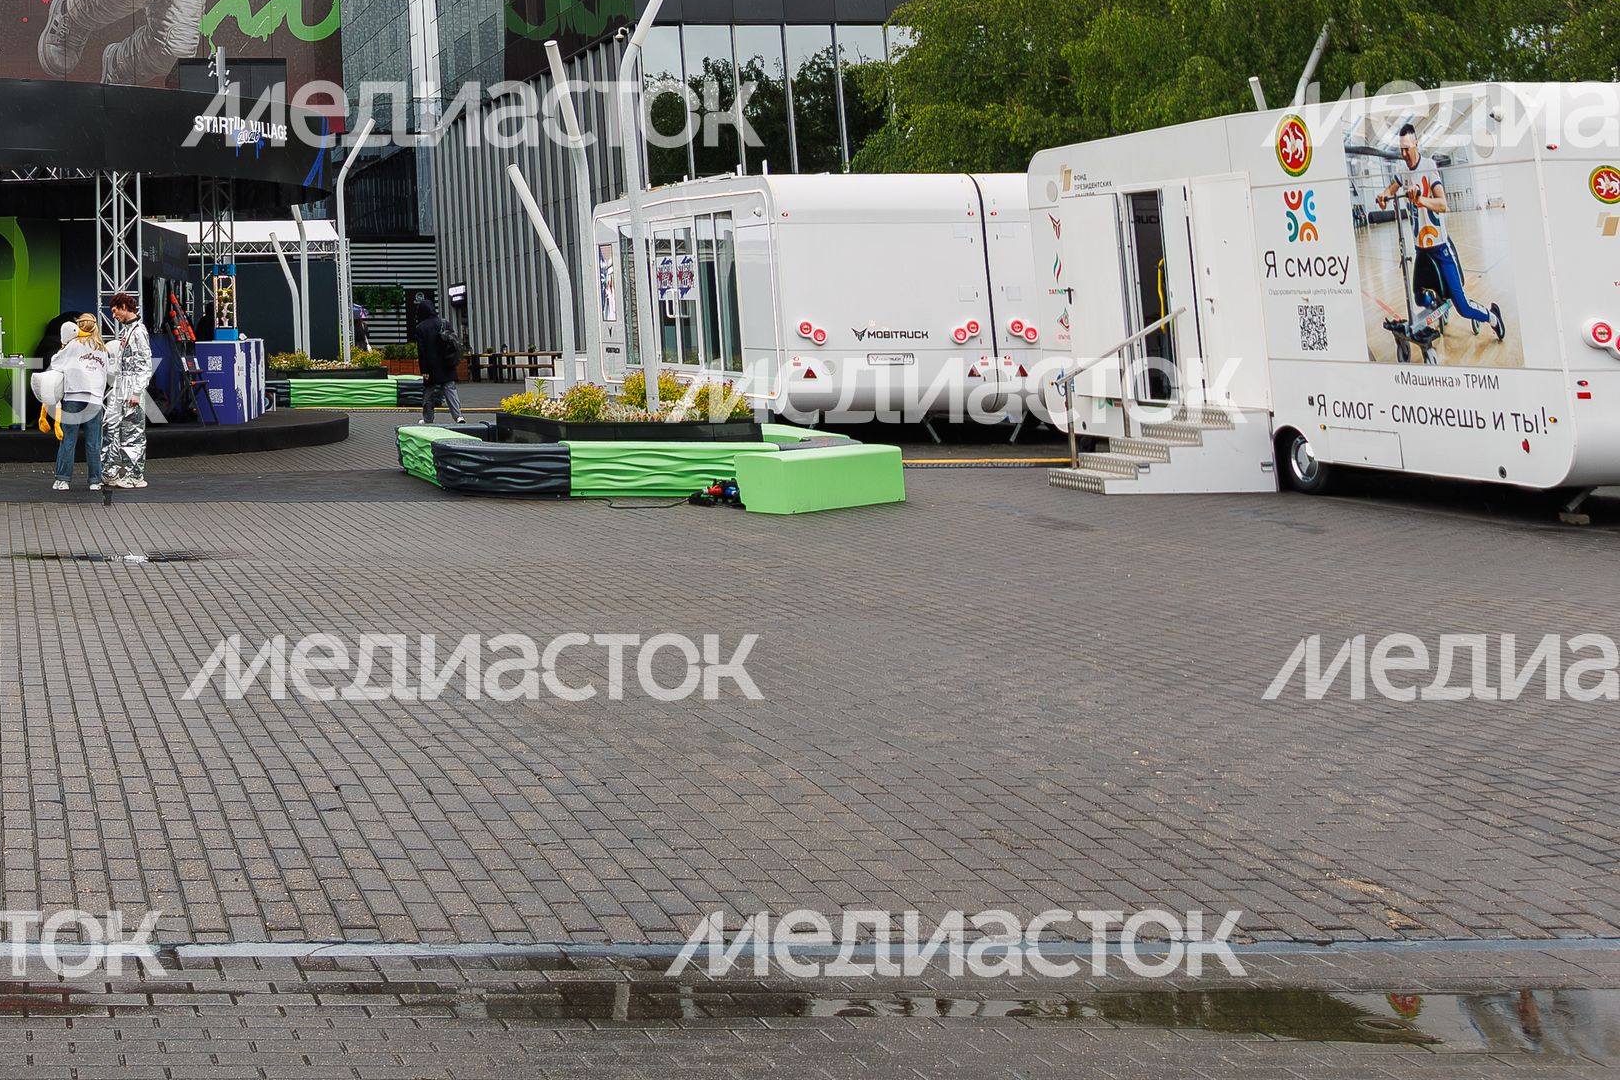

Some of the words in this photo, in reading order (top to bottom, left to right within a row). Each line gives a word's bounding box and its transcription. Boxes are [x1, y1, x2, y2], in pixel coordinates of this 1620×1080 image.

[194, 115, 246, 135] STARTUP
[250, 120, 287, 141] VILLAGE
[1264, 250, 1278, 278] Я
[1284, 256, 1350, 285] смогу
[867, 330, 929, 339] MOBITRUCK
[1394, 371, 1461, 388] «Машинка»
[1463, 373, 1500, 390] ТРИМ
[1332, 400, 1374, 420] смог
[1391, 404, 1486, 429] сможешь
[1492, 411, 1505, 431] и
[1511, 406, 1548, 434] ты!
